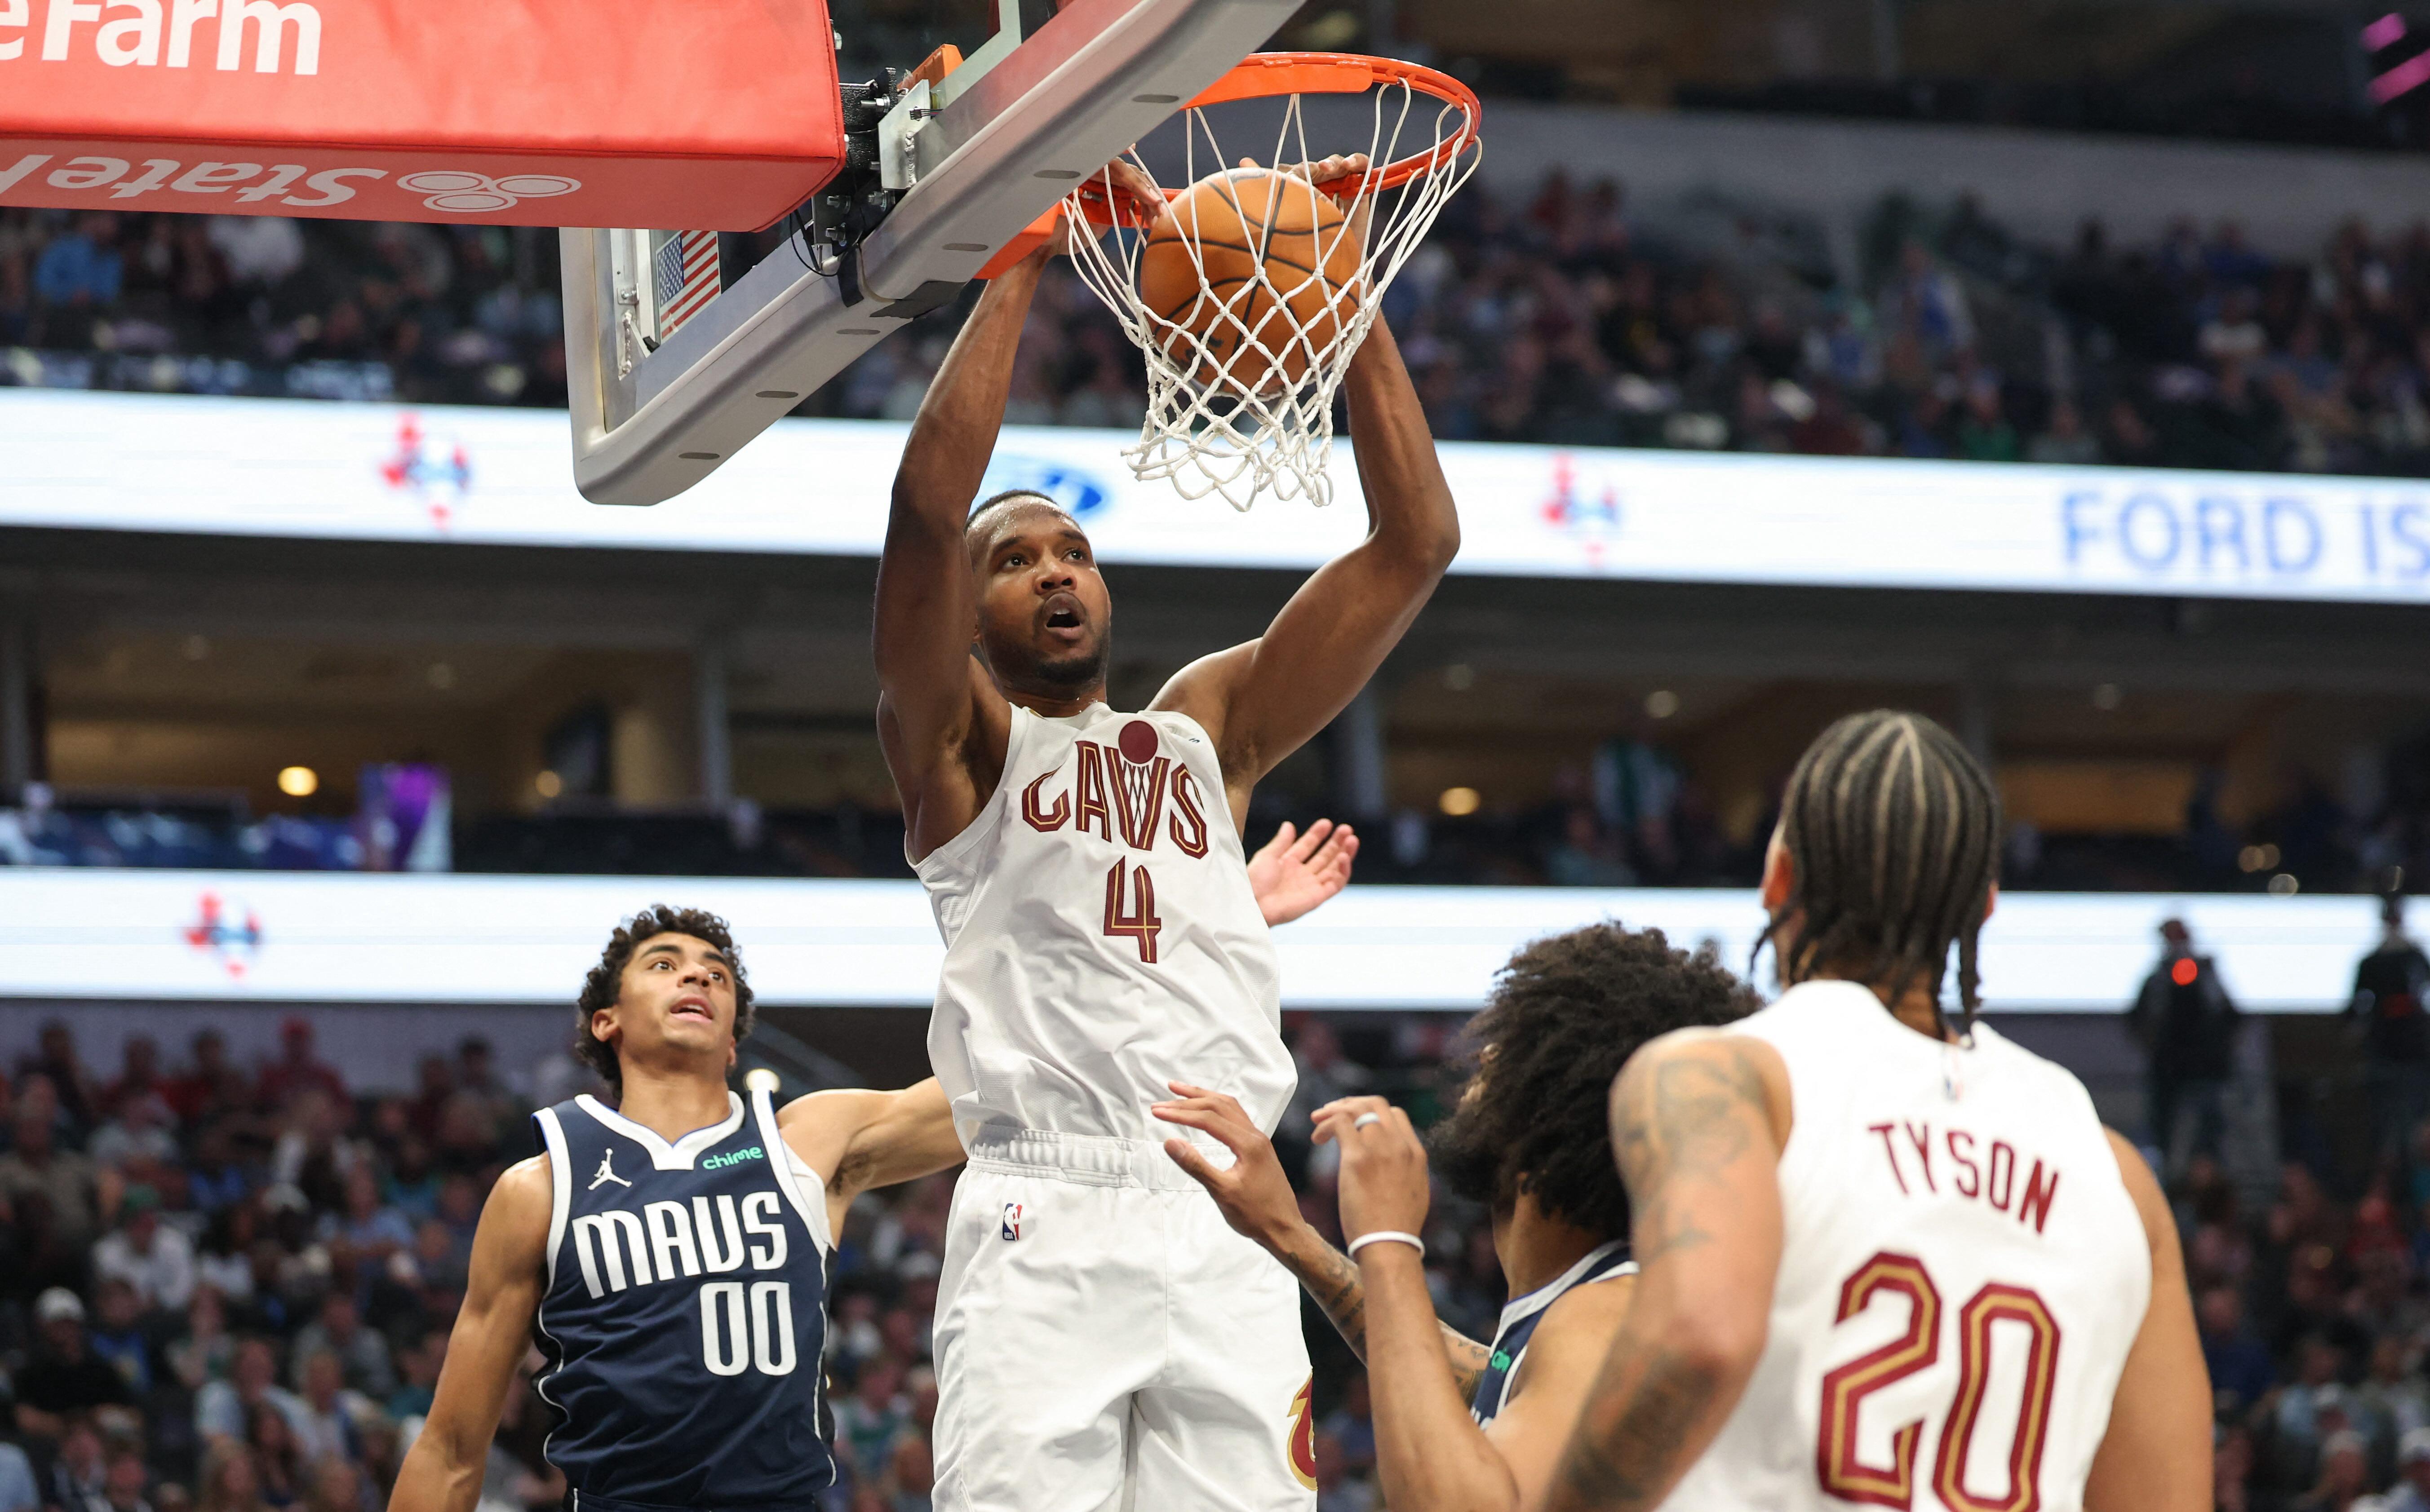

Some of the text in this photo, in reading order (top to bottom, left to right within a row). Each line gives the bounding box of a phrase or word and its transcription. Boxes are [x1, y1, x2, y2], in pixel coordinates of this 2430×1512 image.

[2063, 491, 2325, 575] FORD
[1022, 740, 1209, 860] CAVS
[1103, 855, 1161, 964] 4
[703, 1146, 763, 1170] chime
[1868, 1120, 2059, 1236] TYSON
[572, 1191, 788, 1300] MAVS
[700, 1281, 797, 1376] 00
[1817, 1250, 2062, 1512] 20
